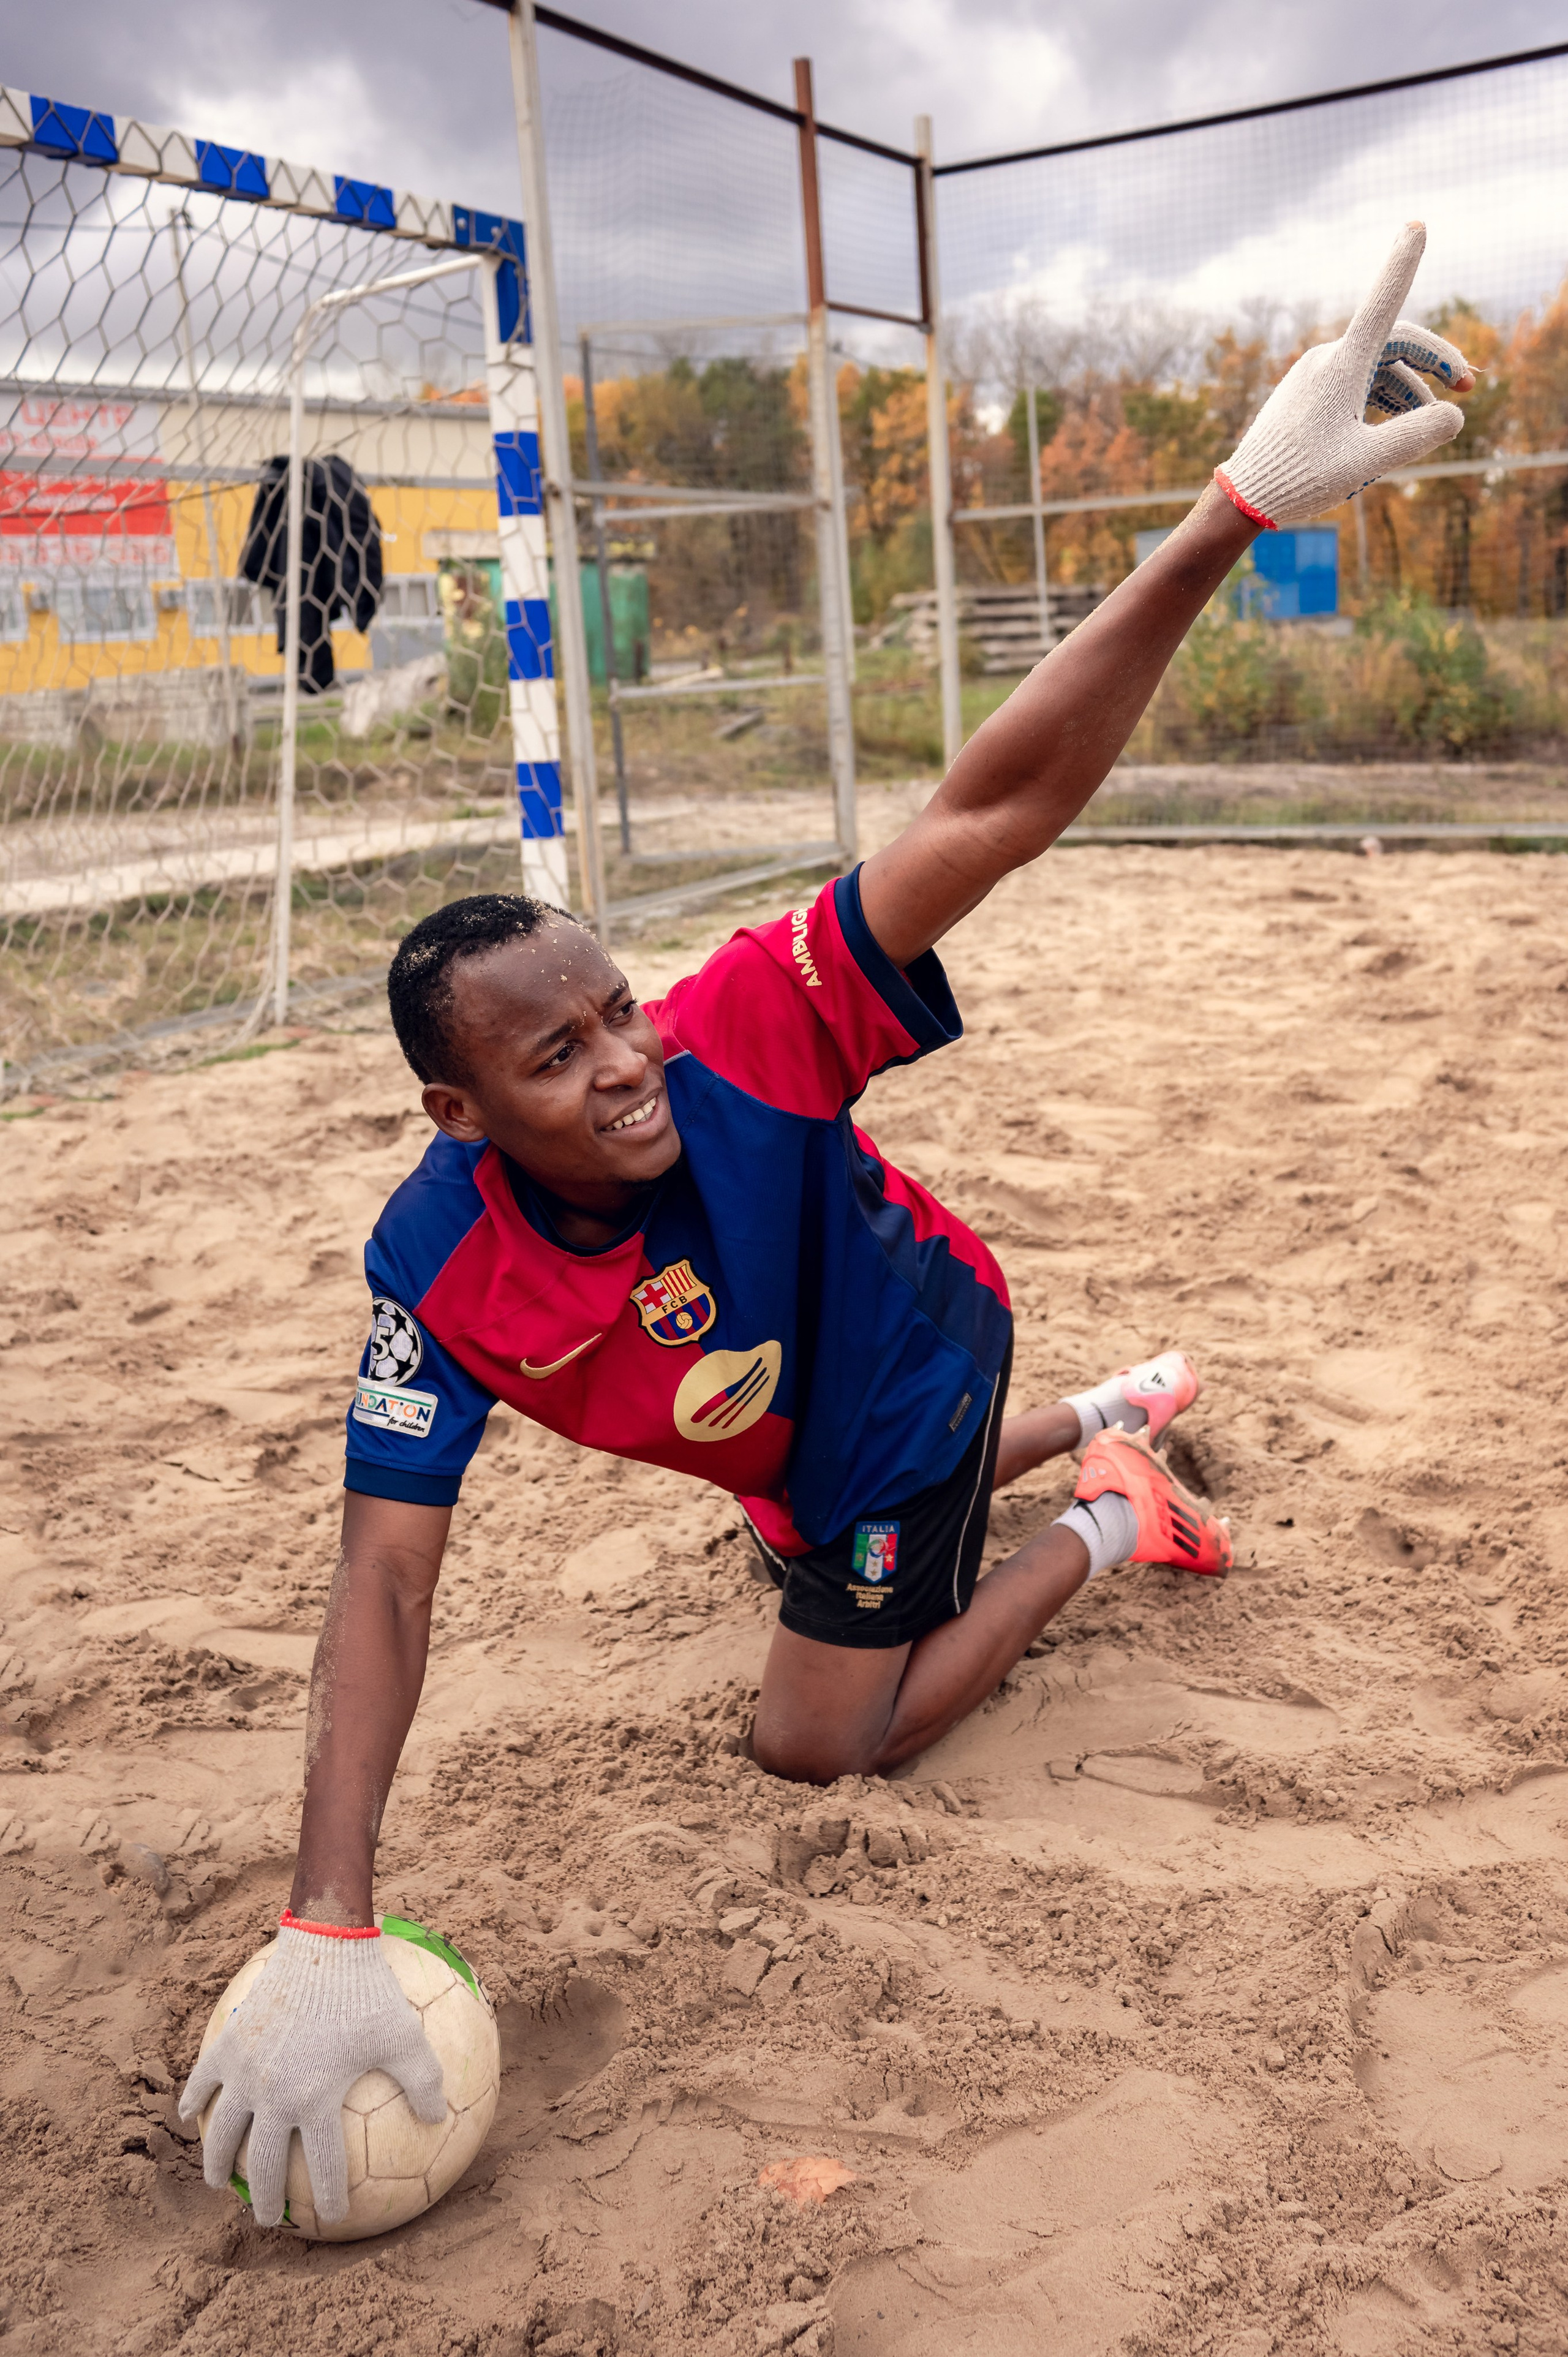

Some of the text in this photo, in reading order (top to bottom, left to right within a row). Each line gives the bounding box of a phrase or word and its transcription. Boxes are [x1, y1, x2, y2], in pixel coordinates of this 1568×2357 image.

[662, 1295, 687, 1314] FCB
[372, 1327, 390, 1360] 5
[386, 1416, 425, 1432] for children
